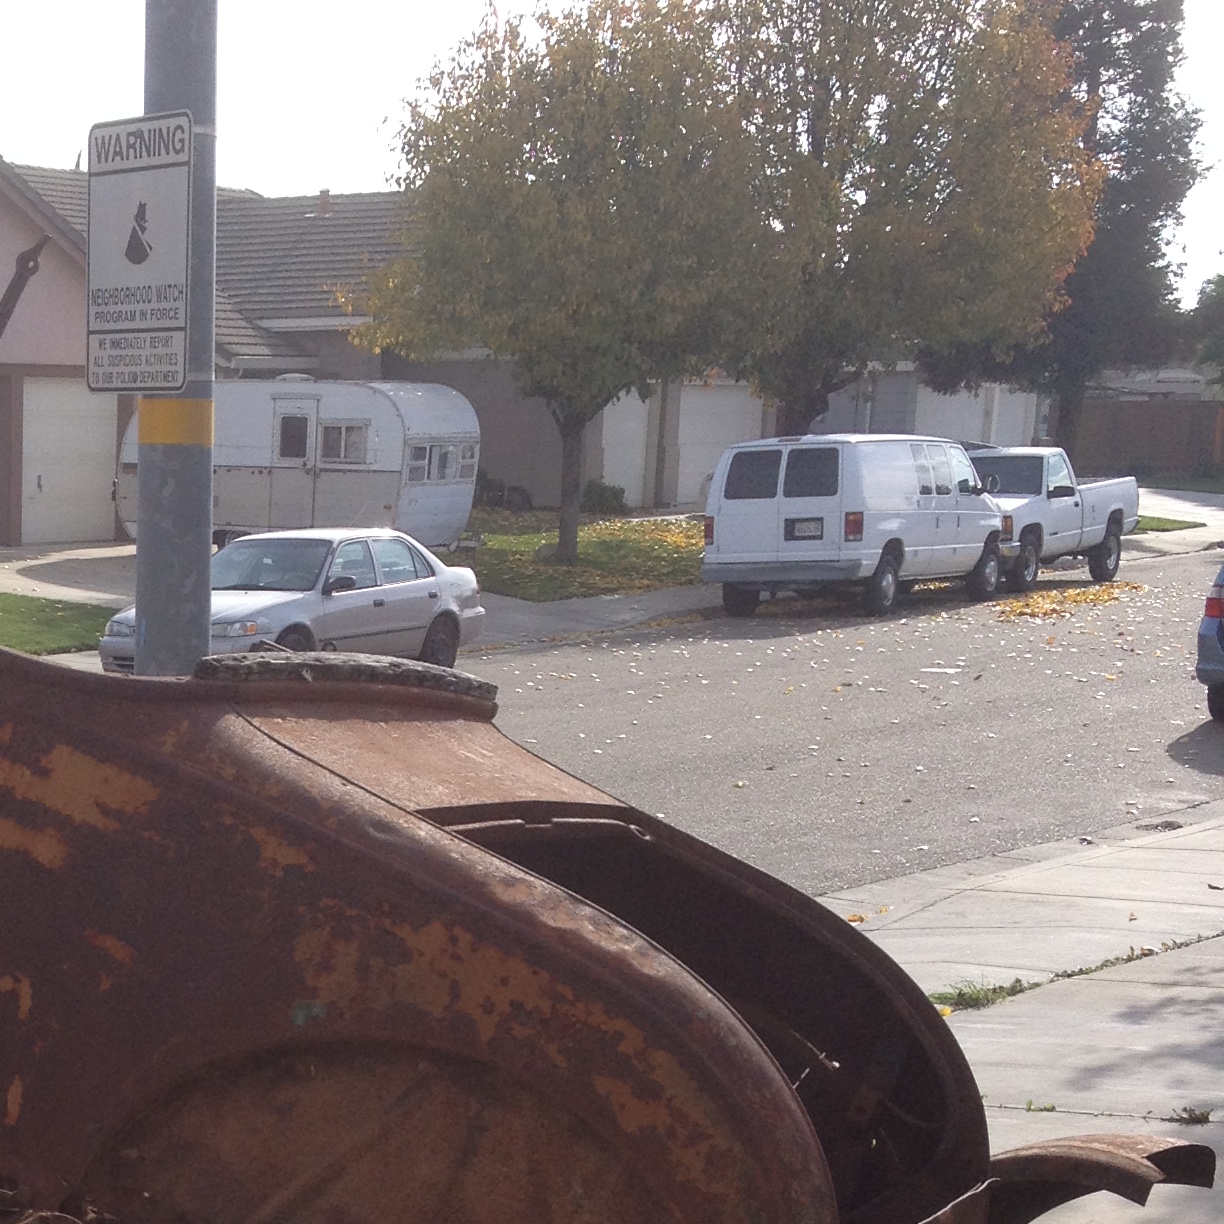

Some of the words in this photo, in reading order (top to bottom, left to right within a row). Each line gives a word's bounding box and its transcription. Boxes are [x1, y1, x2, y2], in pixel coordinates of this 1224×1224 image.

[94, 124, 185, 164] WARNING
[91, 285, 153, 307] NEIGHBORHOOD
[155, 283, 184, 304] WATCH
[94, 310, 137, 324] PROGRAM
[139, 309, 148, 321] IN
[150, 307, 180, 321] FORCE
[109, 336, 146, 350] IMMEDIATELY
[149, 335, 174, 349] REPORT
[94, 354, 104, 367] ALL
[107, 353, 142, 367] SUSPICIOUS
[144, 352, 178, 367] ACTIVITIES
[92, 371, 100, 385] TO
[116, 371, 138, 384] POLI
[139, 370, 179, 384] DEPARTMENT
